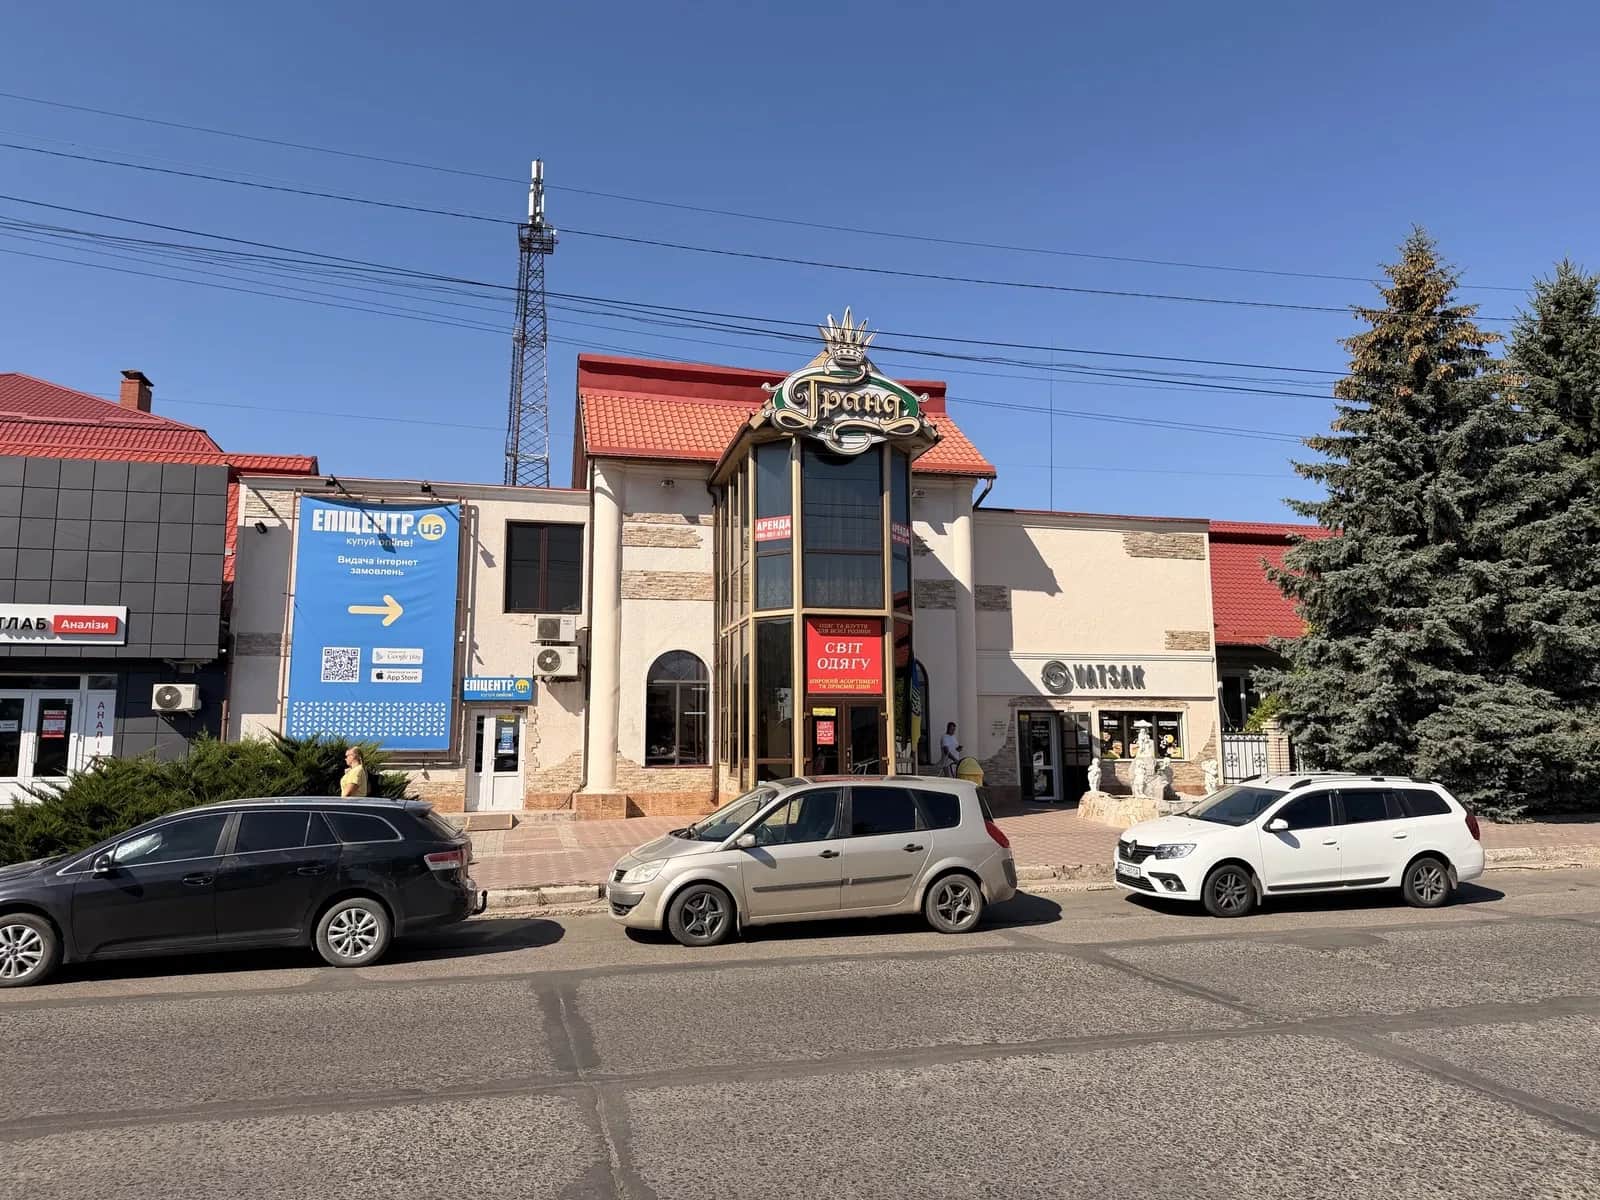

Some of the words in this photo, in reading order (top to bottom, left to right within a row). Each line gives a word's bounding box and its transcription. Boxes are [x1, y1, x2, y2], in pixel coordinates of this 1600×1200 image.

[757, 517, 791, 531] АРЕНДА
[346, 538, 376, 548] купуй
[337, 555, 374, 566] Видача
[350, 567, 405, 576] замовлень
[61, 619, 109, 630] Аналізи
[824, 641, 863, 654] СВІТ
[817, 657, 871, 670] ОДЯГУ
